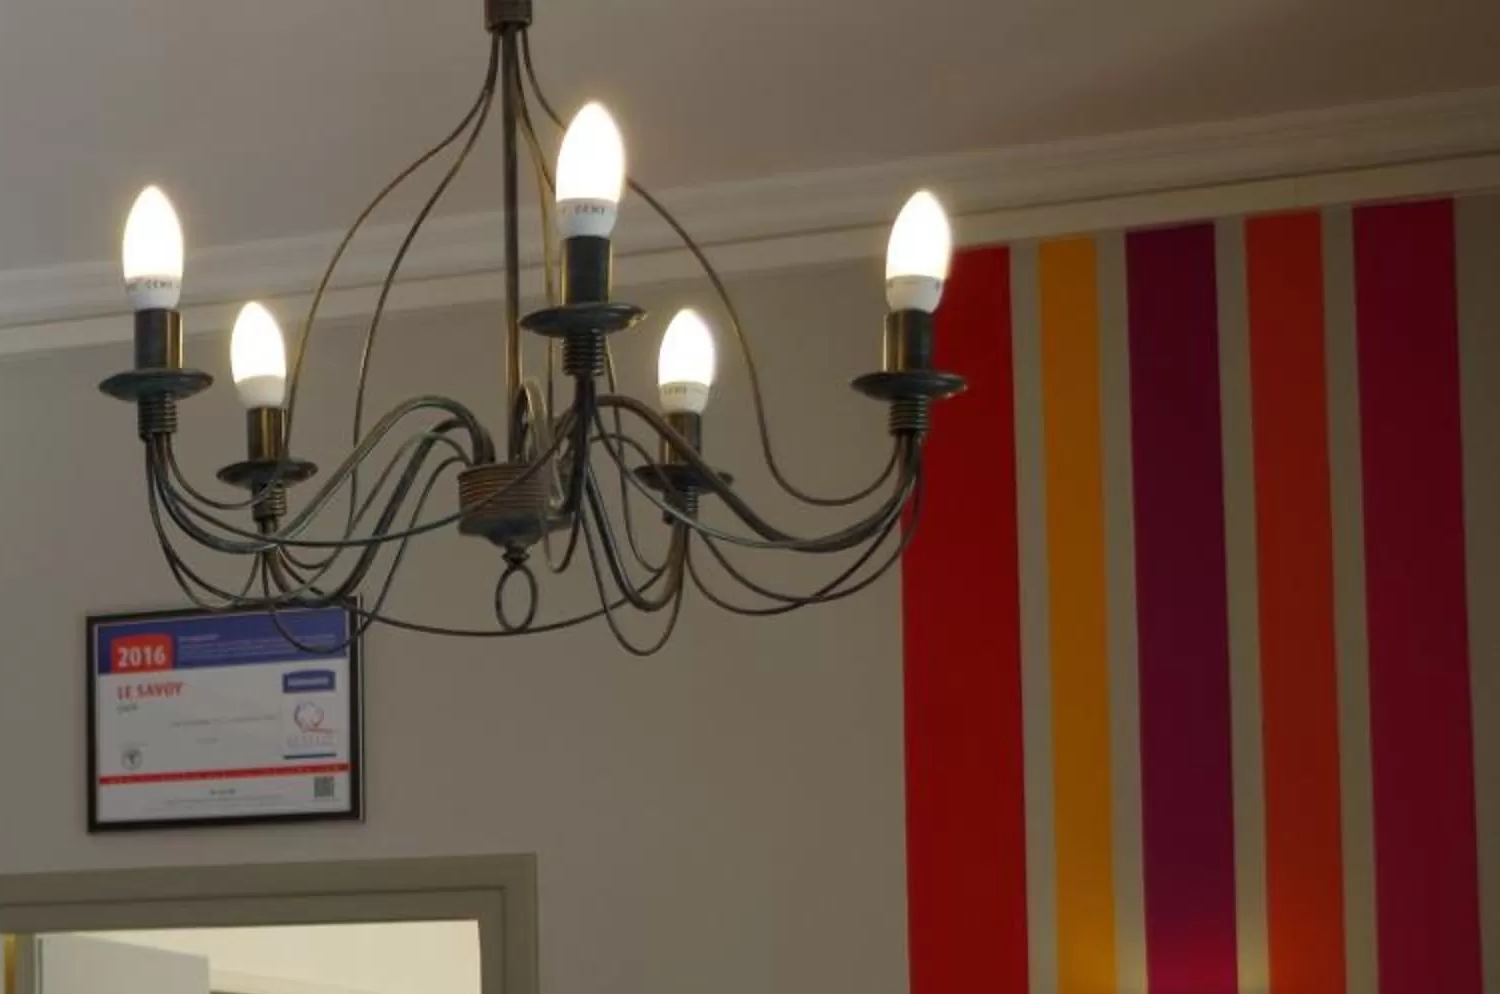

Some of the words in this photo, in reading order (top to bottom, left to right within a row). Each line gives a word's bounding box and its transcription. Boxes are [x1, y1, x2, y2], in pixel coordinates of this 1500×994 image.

[117, 644, 167, 667] 2016
[116, 684, 133, 700] LE
[136, 681, 184, 699] SAVOY
